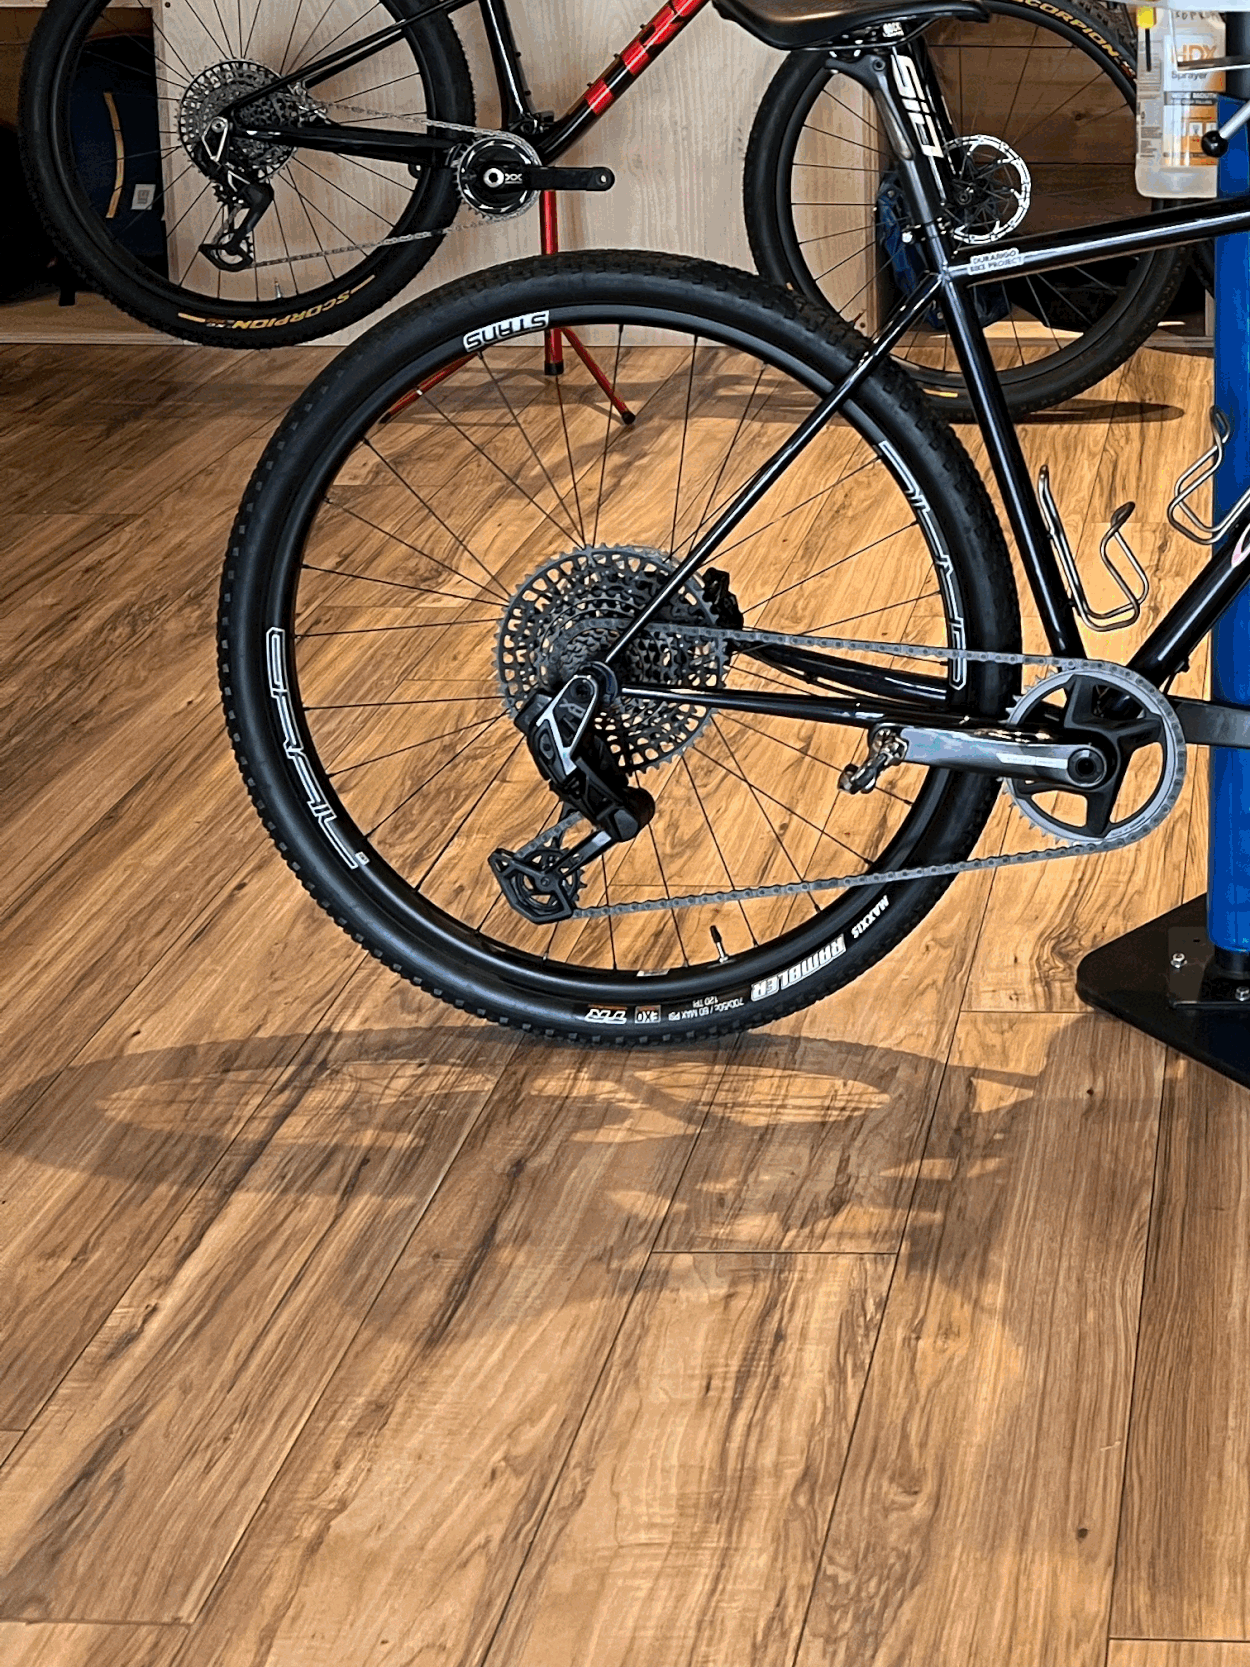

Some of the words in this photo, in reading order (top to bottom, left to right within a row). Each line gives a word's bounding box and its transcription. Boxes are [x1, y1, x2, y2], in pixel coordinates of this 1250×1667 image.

[231, 290, 351, 330] SCORPION
[851, 894, 890, 939] MAXXIS
[751, 934, 846, 1002] RAMBLER
